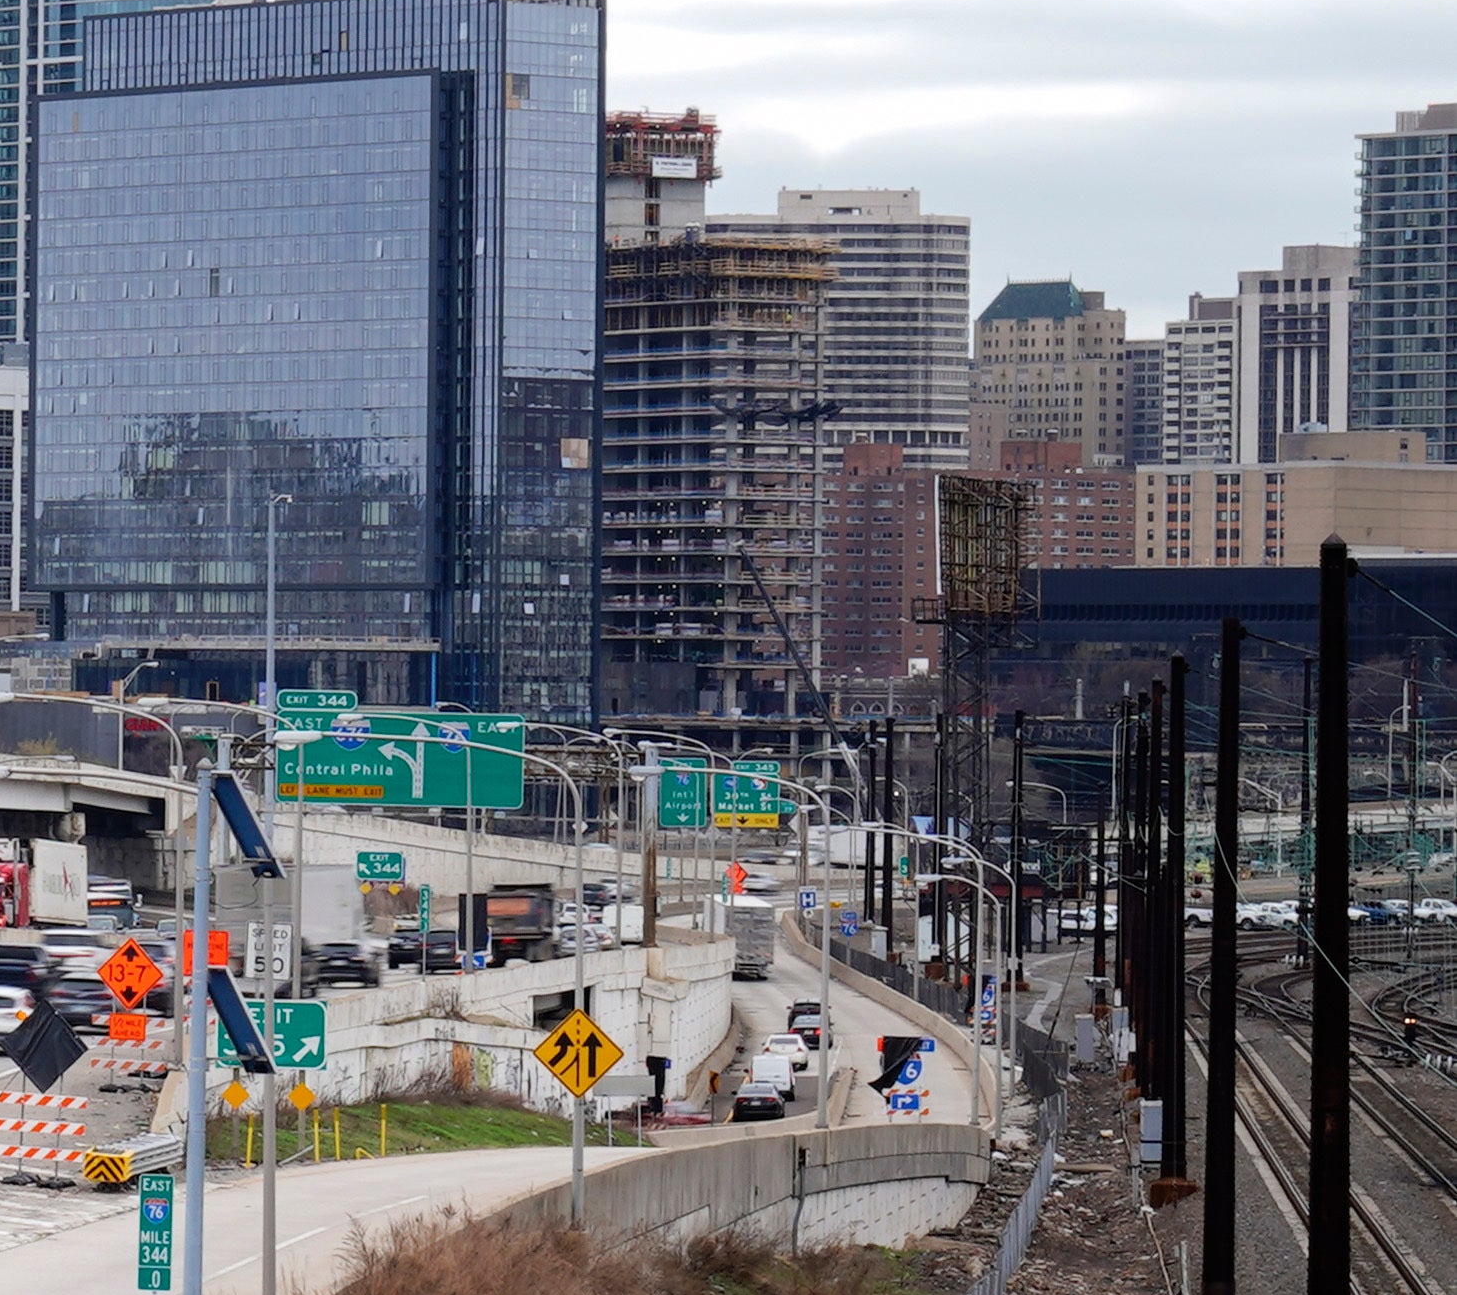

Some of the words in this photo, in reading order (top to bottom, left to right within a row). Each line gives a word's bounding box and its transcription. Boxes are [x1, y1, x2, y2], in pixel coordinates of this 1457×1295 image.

[286, 695, 308, 704] EXIT
[318, 695, 348, 707] 344
[477, 721, 517, 734] EAT
[284, 762, 345, 775] Central
[351, 763, 394, 775] Phila
[280, 785, 299, 795] LEF
[307, 786, 330, 796] LANE
[336, 787, 358, 796] MUST
[369, 854, 389, 862] EXIT
[373, 863, 401, 874] 344
[252, 928, 288, 939] SPED
[842, 923, 857, 935] 76
[254, 943, 285, 952] LIIT
[254, 957, 285, 974] 50
[251, 1008, 294, 1024] EIT
[904, 1062, 917, 1079] 6
[142, 1177, 171, 1192] EAST
[148, 1205, 164, 1219] 76
[140, 1230, 170, 1245] MILE
[142, 1245, 169, 1263] 344
